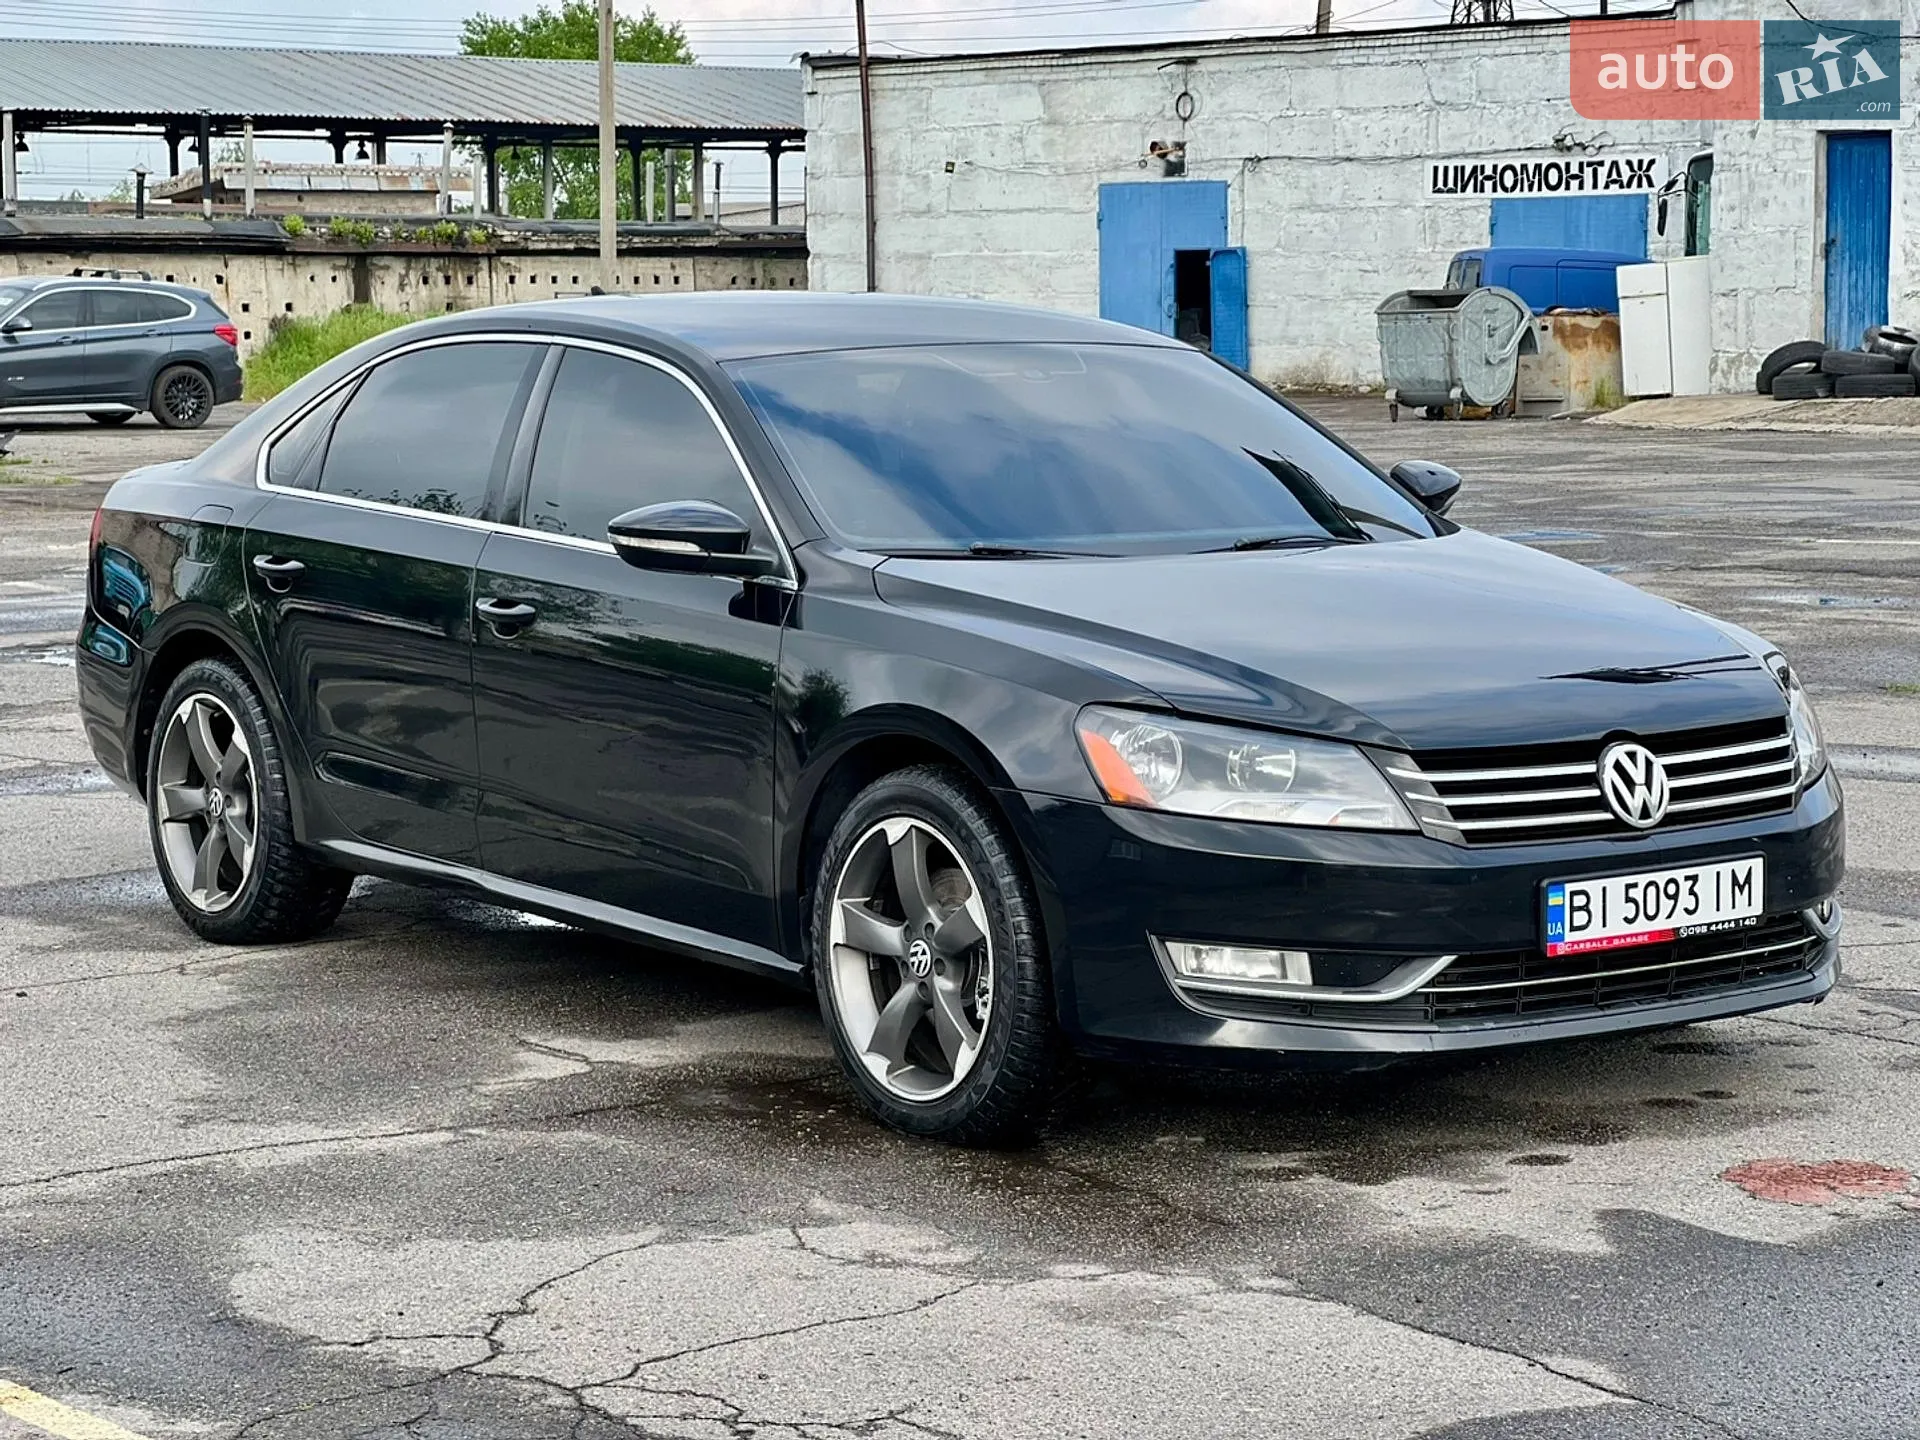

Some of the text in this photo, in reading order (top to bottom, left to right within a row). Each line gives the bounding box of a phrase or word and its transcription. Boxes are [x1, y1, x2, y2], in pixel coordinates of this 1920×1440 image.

[1431, 157, 1657, 195] ШИНОМОНТАЖ
[1568, 865, 1753, 933] BI 5093 IM
[1547, 922, 1563, 936] UA
[1710, 920, 1736, 932] 4444
